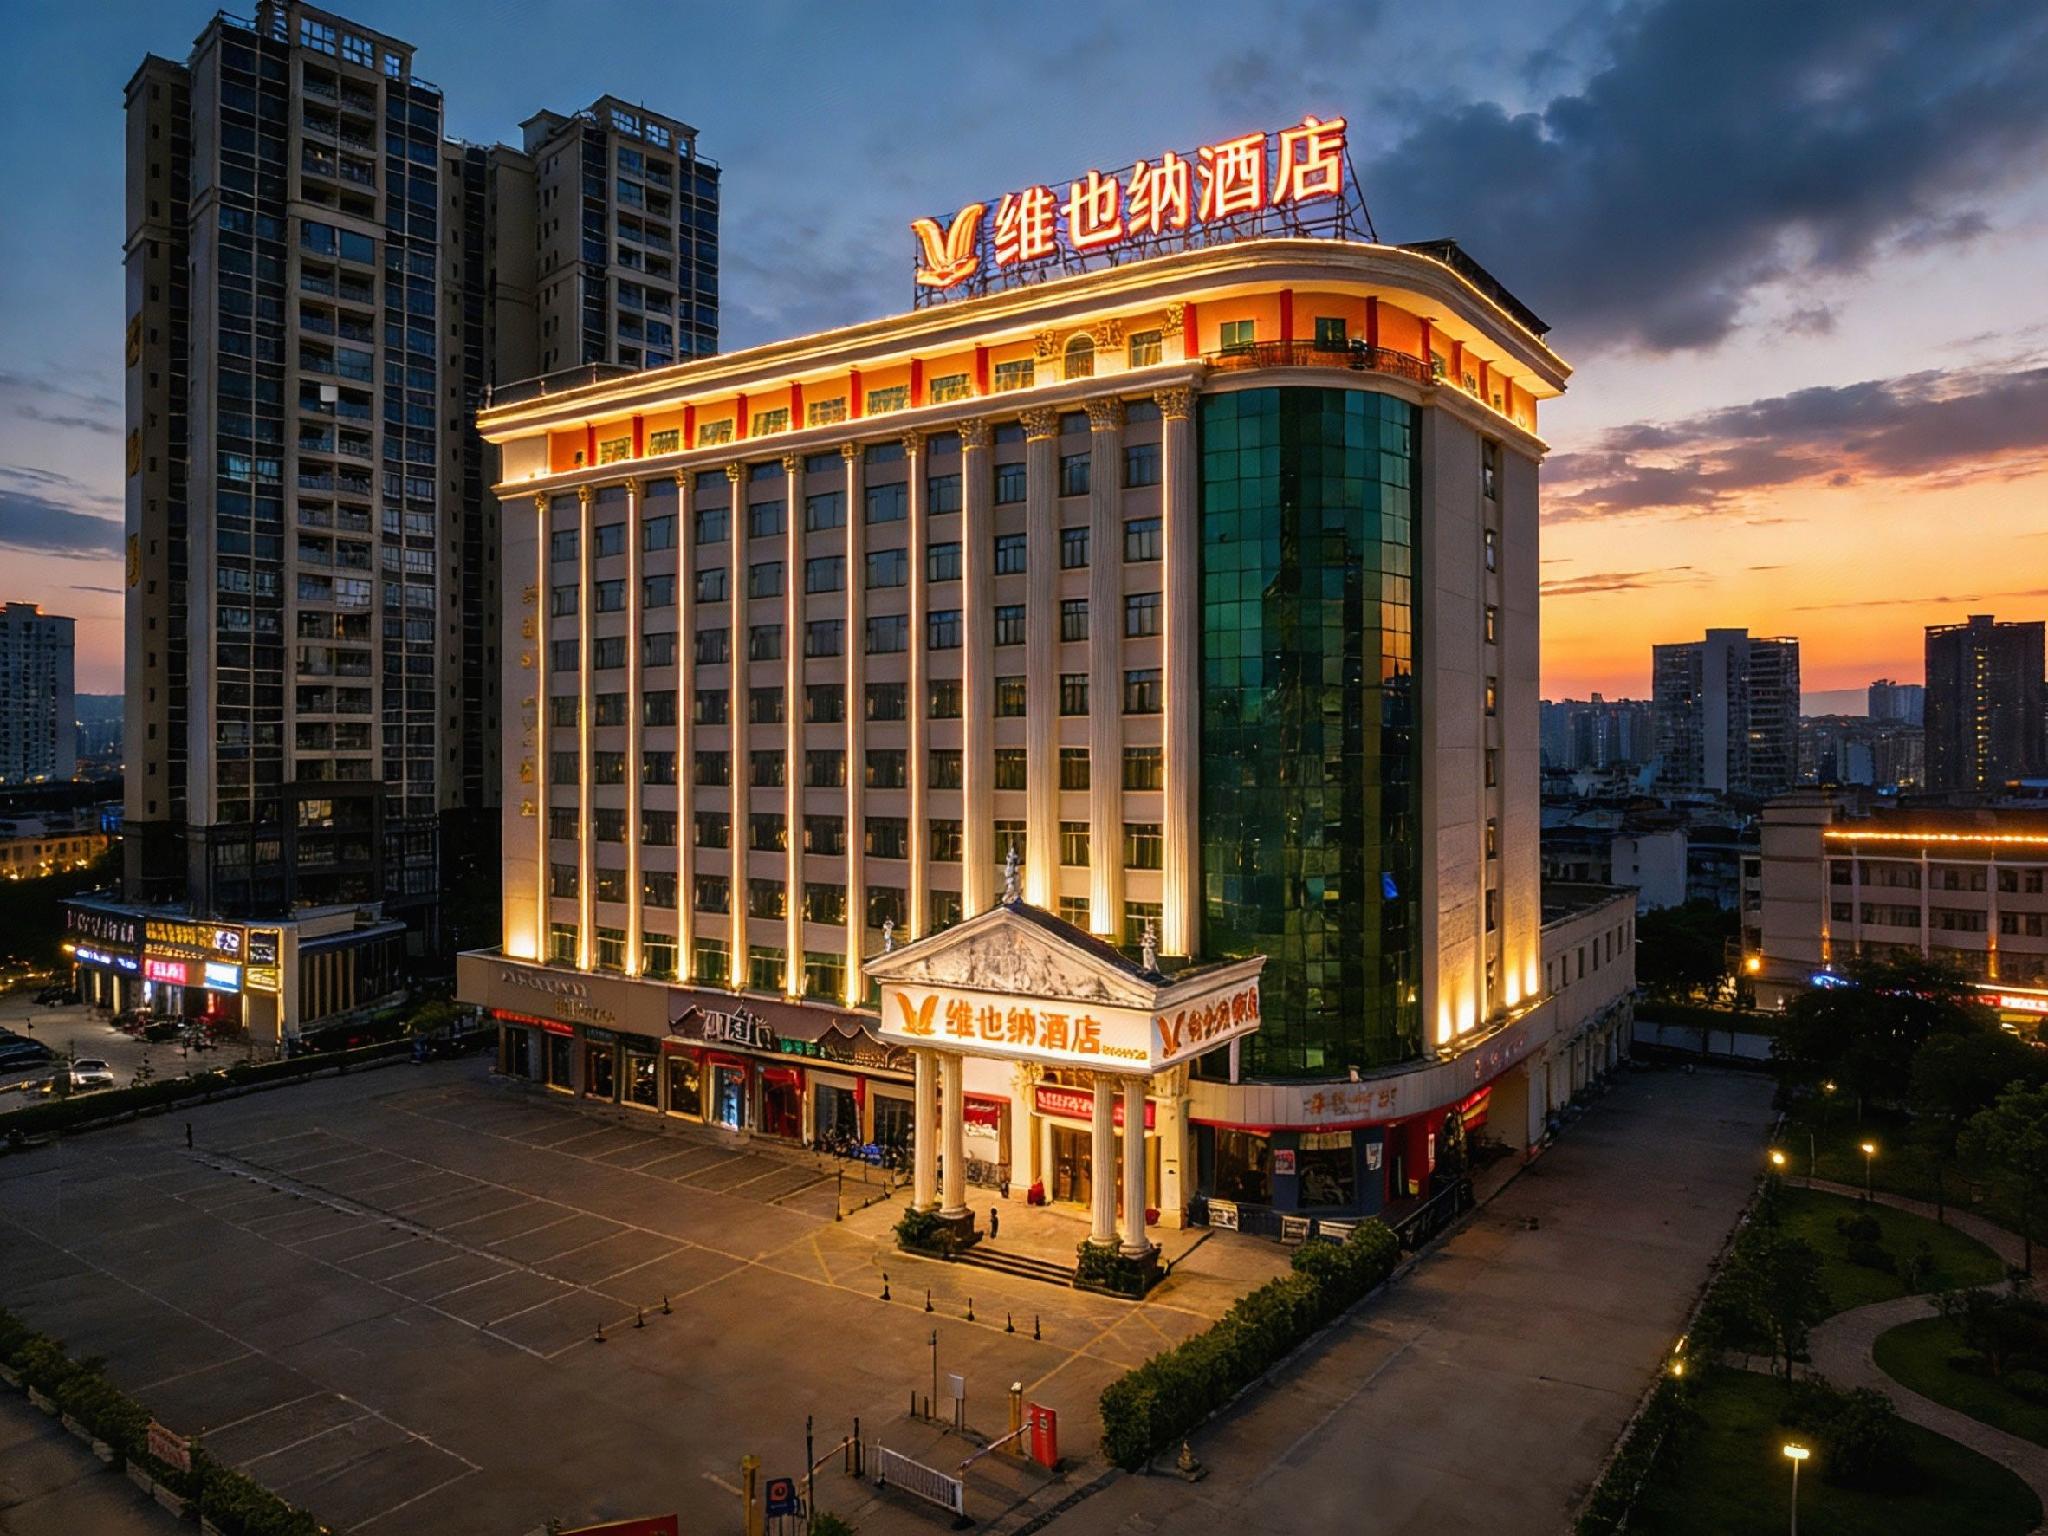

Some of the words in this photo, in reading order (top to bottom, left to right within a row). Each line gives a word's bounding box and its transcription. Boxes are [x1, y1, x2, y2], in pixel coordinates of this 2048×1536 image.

[994, 115, 1346, 265] 维也纳酒店
[945, 999, 1101, 1055] 维也纳酒店
